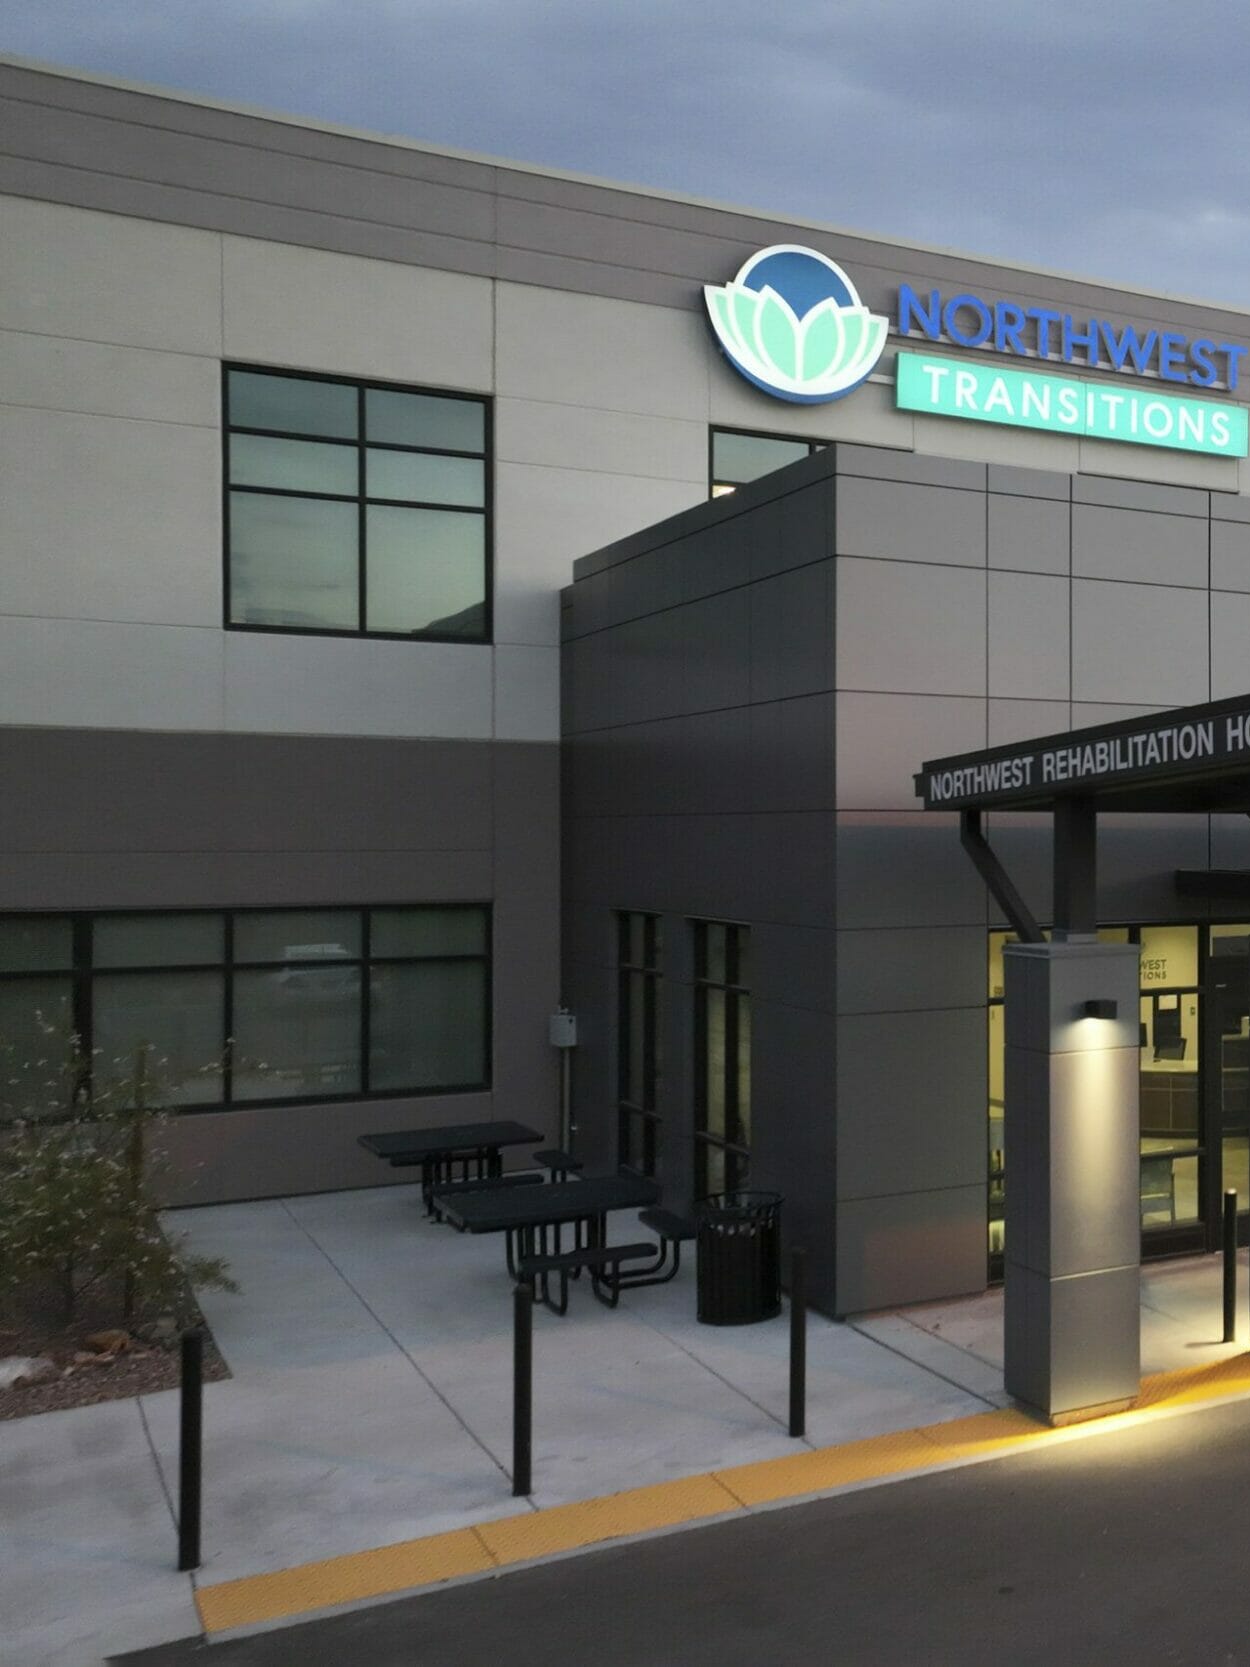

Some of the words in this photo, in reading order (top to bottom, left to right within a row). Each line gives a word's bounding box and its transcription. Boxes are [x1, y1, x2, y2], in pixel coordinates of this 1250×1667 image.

[898, 283, 1249, 391] NORTHWEST
[922, 364, 1230, 447] TRANSITIONS
[930, 756, 1034, 801] NORTHWEST
[1042, 722, 1214, 783] REHABILITATION
